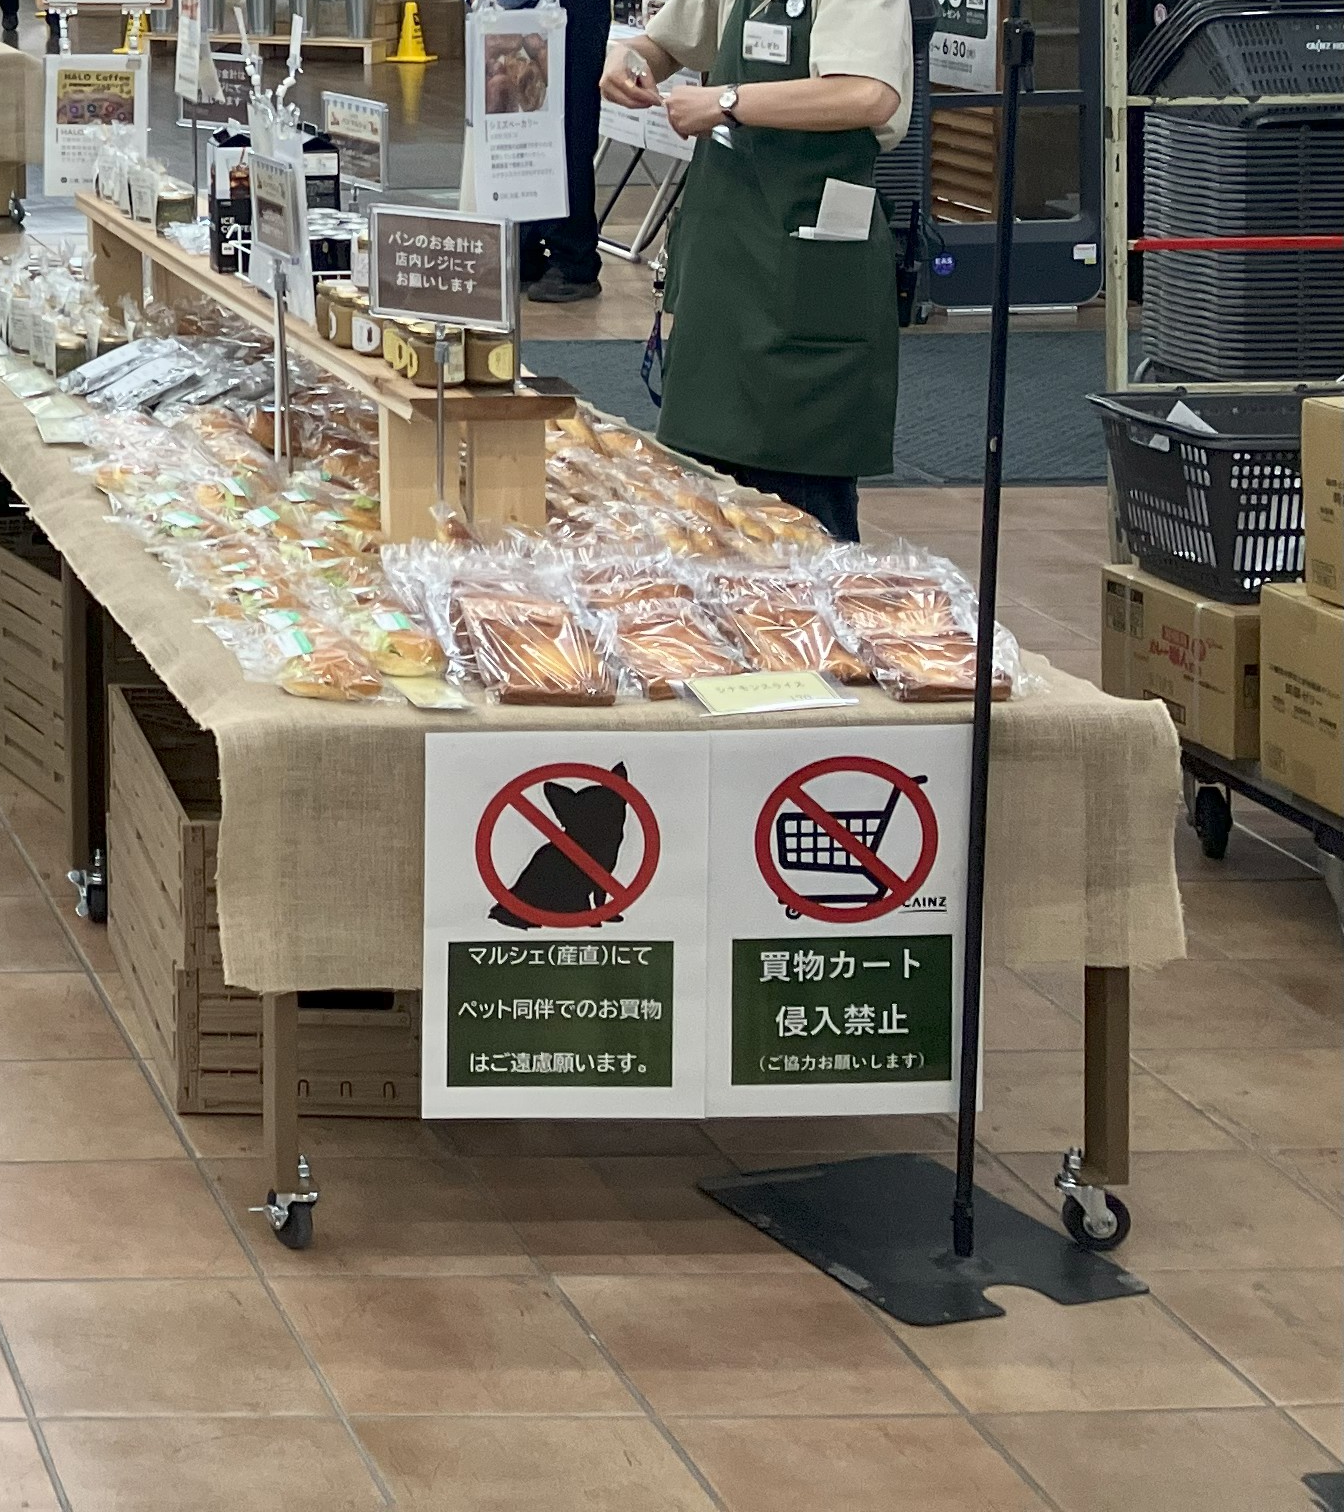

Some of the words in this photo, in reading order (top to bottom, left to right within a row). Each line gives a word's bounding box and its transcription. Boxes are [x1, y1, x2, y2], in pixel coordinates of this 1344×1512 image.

[64, 73, 91, 81] HALO
[96, 72, 131, 81] Coffee
[220, 217, 235, 225] ICE
[388, 231, 484, 255] パンのお会計は
[395, 251, 476, 274] 店内レジにて
[935, 256, 953, 265] EAS
[396, 271, 478, 295] お願いします
[902, 895, 947, 908] CAINZ
[468, 944, 653, 968] マルシェ(産直)にて
[759, 948, 921, 983] 買物カート
[457, 998, 662, 1023] ペット同伴でのお買物
[775, 1002, 909, 1037] 侵入禁止
[469, 1051, 650, 1075] はご遠慮願います。
[759, 1051, 925, 1073] (ご協力お願いします)
